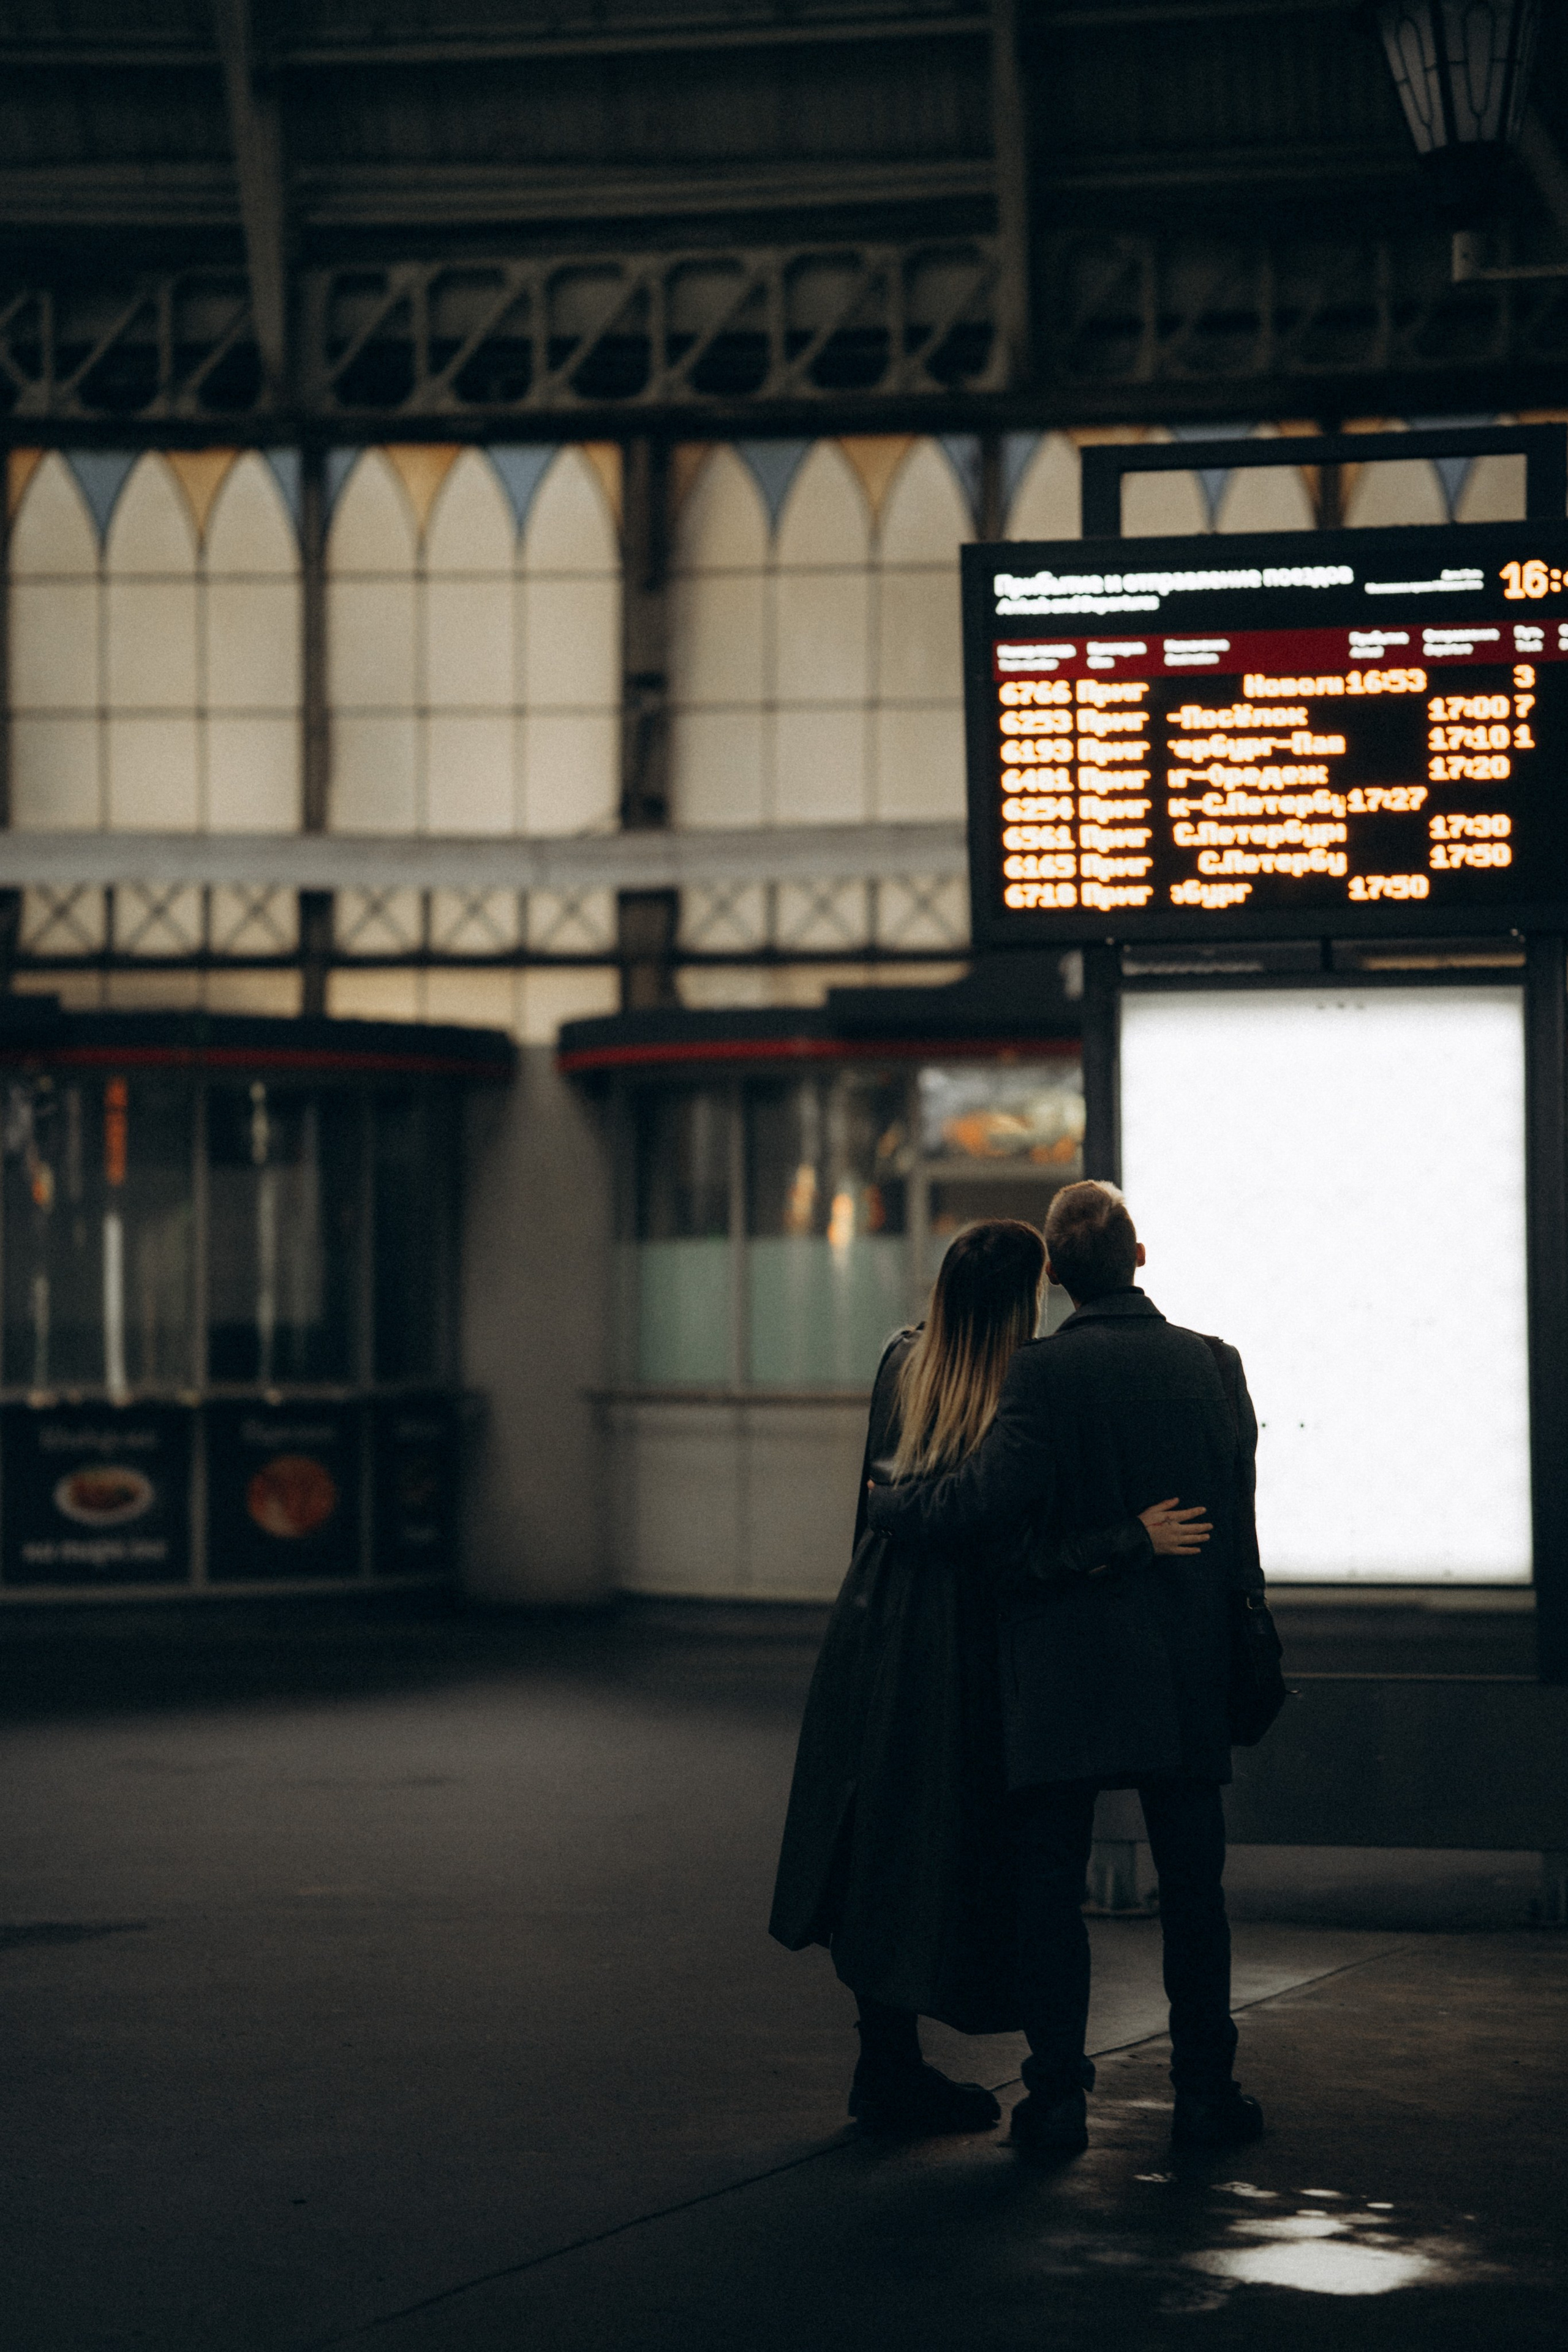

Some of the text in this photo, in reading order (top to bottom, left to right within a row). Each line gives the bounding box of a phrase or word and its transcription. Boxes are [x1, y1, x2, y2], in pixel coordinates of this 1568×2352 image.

[1500, 560, 1568, 599] 16:
[999, 681, 1072, 706] 6766
[1076, 679, 1149, 707] Приг
[1346, 668, 1427, 694] 16:53
[1513, 665, 1535, 688] 3
[1000, 709, 1073, 735] 6253
[1076, 708, 1149, 736] Приг
[1428, 696, 1510, 721] 17:00
[1514, 694, 1535, 718] 7
[1000, 738, 1074, 764] 6193
[1077, 738, 1150, 766] Приг
[1428, 725, 1510, 751] 17:10
[1513, 724, 1534, 748] 1
[1001, 767, 1074, 793] 6481
[1077, 767, 1151, 795] Приг
[1428, 755, 1510, 780] 17:20
[1002, 797, 1075, 822] 6254
[1078, 796, 1152, 824] Приг
[1347, 786, 1428, 813] 17:27
[1003, 826, 1076, 851] 6561
[1079, 826, 1152, 853] Приг
[1429, 815, 1511, 839] 17:30
[1004, 855, 1076, 880] 6165
[1080, 854, 1153, 883] Приг
[1430, 843, 1512, 869] 17:50
[1005, 884, 1077, 908] 6718
[1080, 884, 1153, 911] Приг
[1348, 875, 1429, 900] 17:50
